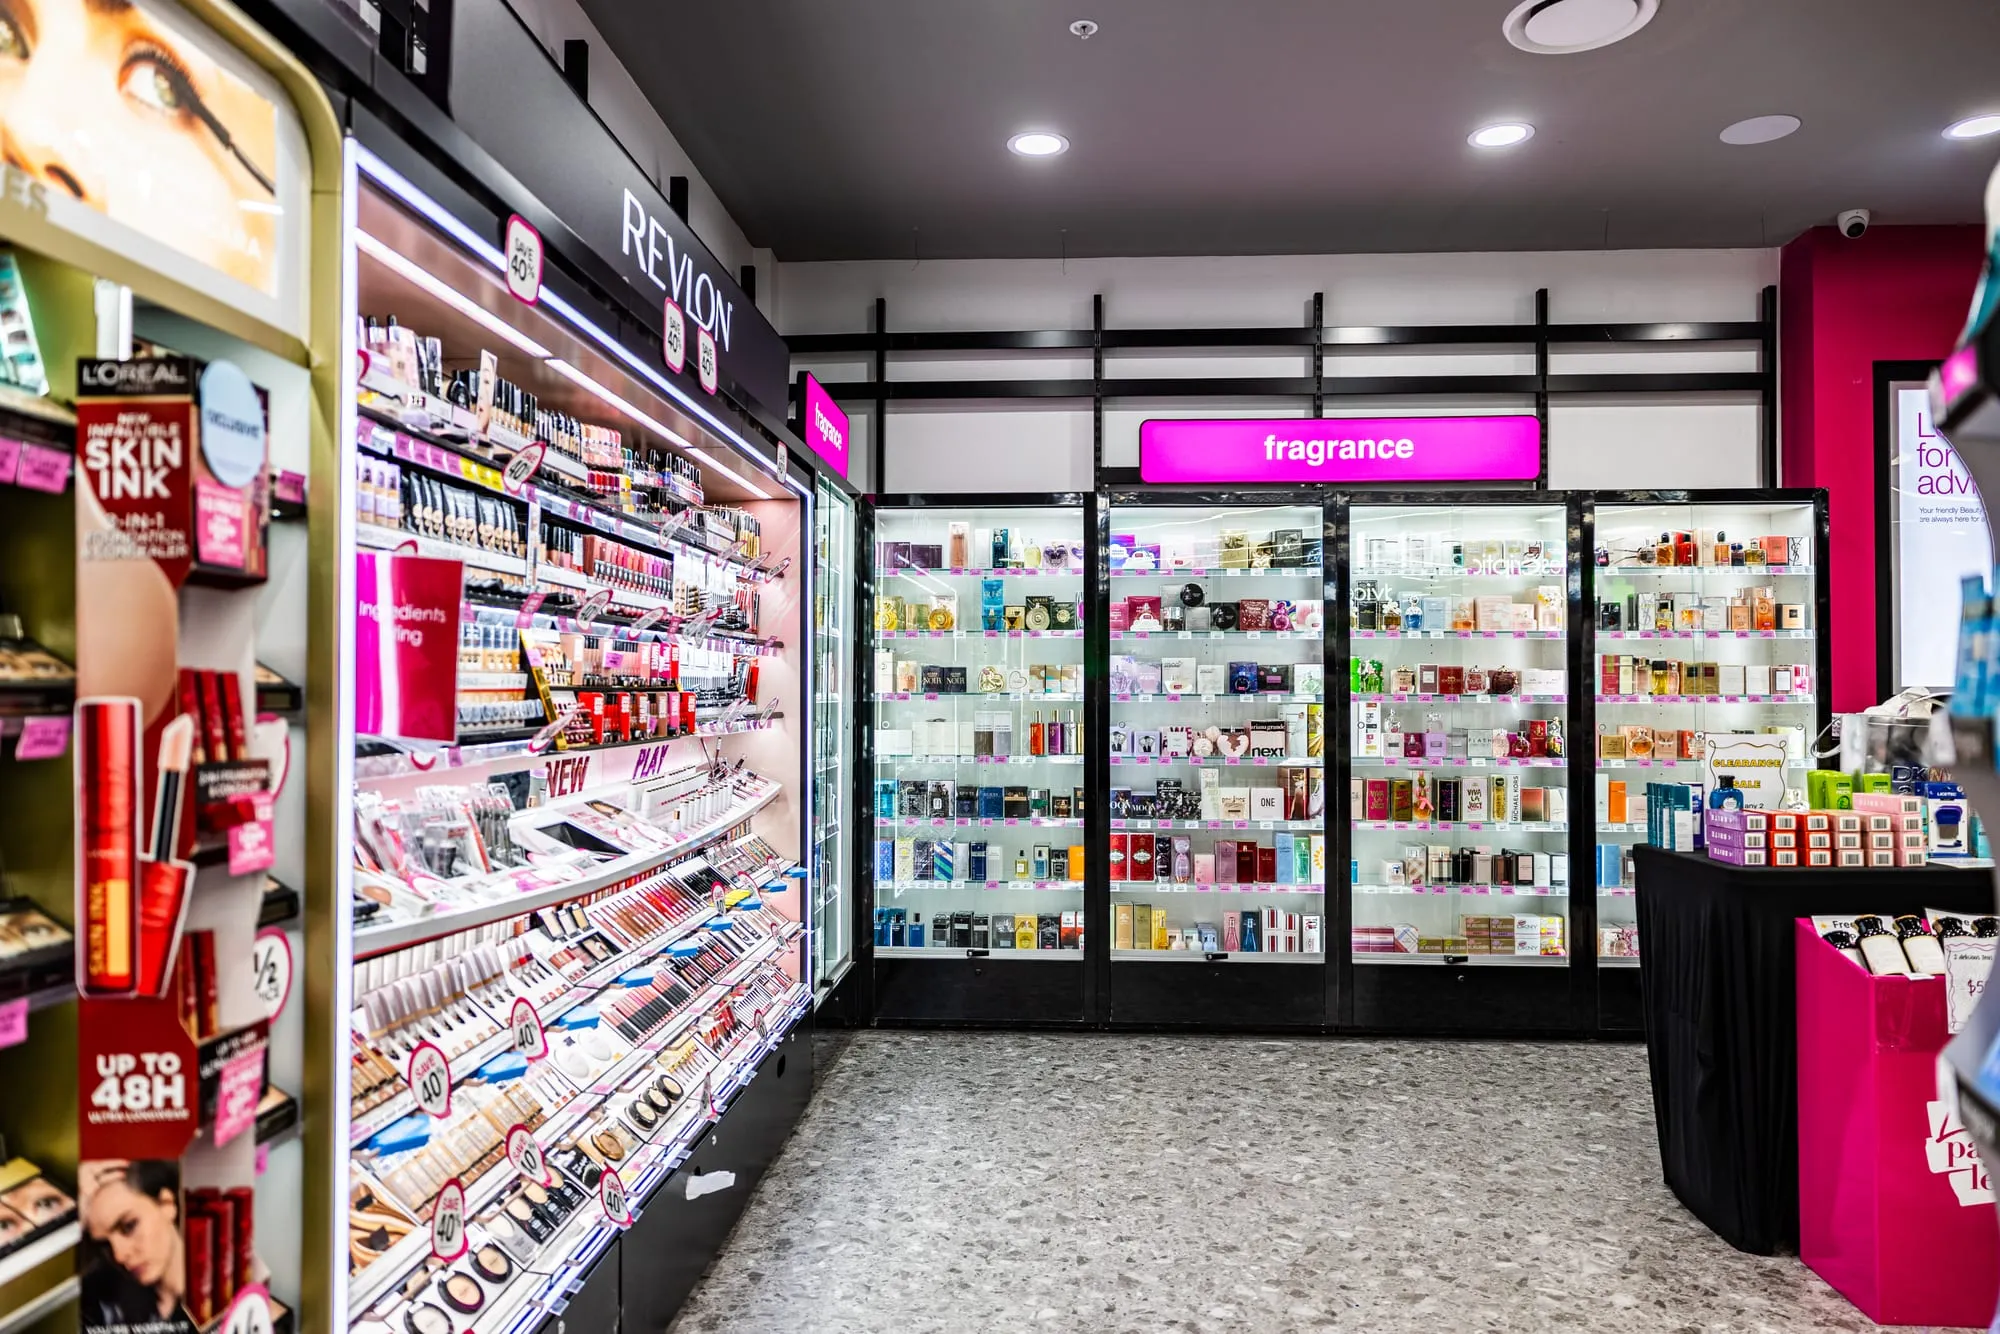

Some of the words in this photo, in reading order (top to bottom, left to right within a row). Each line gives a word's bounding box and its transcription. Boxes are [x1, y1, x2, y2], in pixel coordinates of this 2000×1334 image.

[515, 237, 534, 262] SAVE
[623, 188, 731, 352] REVLON
[670, 317, 681, 332] SAVE
[702, 343, 713, 359] SAVE
[815, 401, 843, 452] fragrance
[86, 438, 182, 470] SKIN
[1263, 434, 1414, 466] fragrance
[1916, 442, 1954, 467] for
[99, 468, 171, 499] INK
[1936, 506, 1959, 516] friendly
[632, 744, 670, 780] PLAY
[1252, 747, 1284, 757] next
[1713, 759, 1782, 768] CLEARANCE
[545, 756, 590, 798] NEW
[1512, 775, 1520, 793] KORS
[1733, 780, 1761, 789] SALE
[1260, 798, 1275, 808] ONE
[1512, 793, 1520, 821] MICHAEL
[516, 1010, 529, 1026] SAVE
[96, 1053, 136, 1078] UP
[140, 1051, 182, 1075] TO
[415, 1053, 436, 1080] SAVE
[91, 1074, 185, 1111] 48H
[606, 1179, 620, 1193] SAVE
[443, 1198, 459, 1211] SAVE
